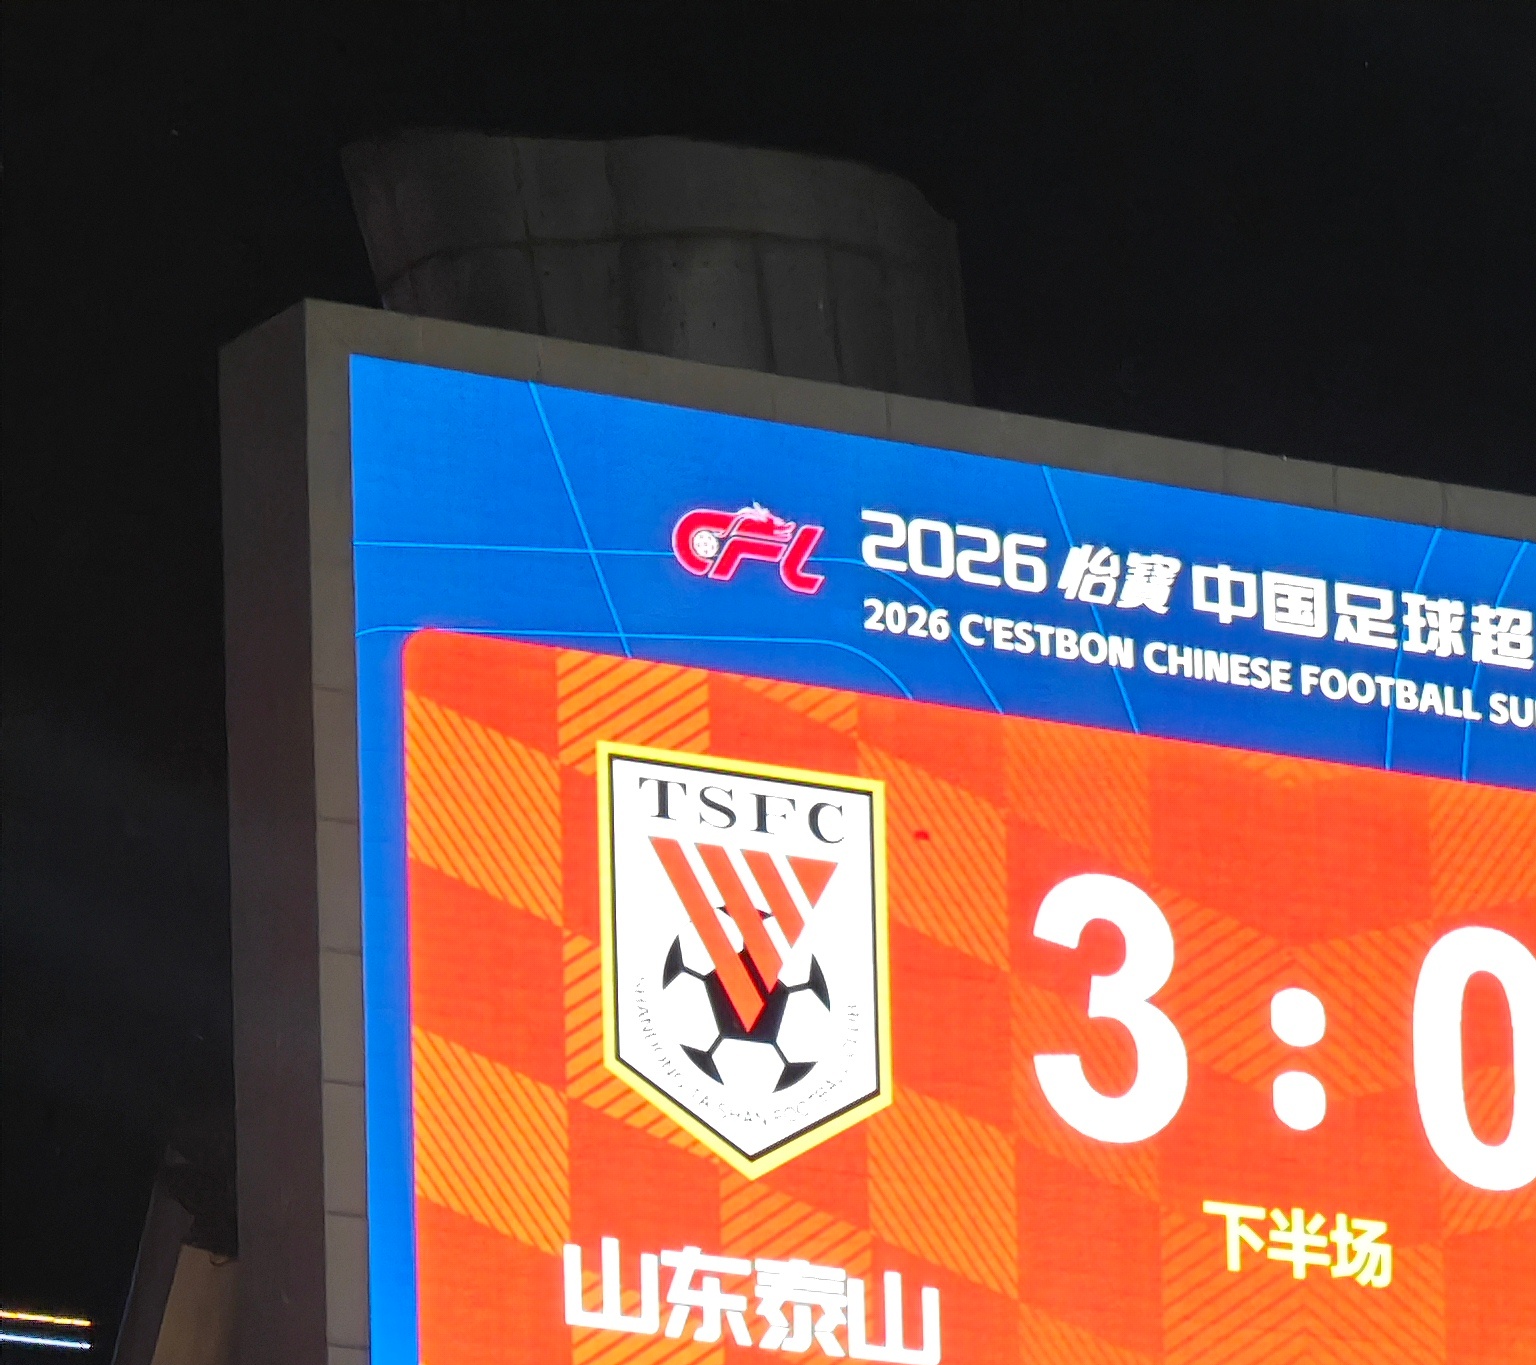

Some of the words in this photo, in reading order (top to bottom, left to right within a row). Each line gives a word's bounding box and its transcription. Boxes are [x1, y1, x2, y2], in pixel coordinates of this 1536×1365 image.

[860, 509, 1047, 593] 2026
[862, 597, 949, 641] 2026
[959, 613, 1134, 669] C'ESTBON
[1143, 641, 1292, 693] CHINESE
[1300, 664, 1481, 720] FOOTBALL
[638, 777, 844, 845] TSFC
[1033, 873, 1188, 1143] 3
[1203, 1200, 1393, 1288] 下半场
